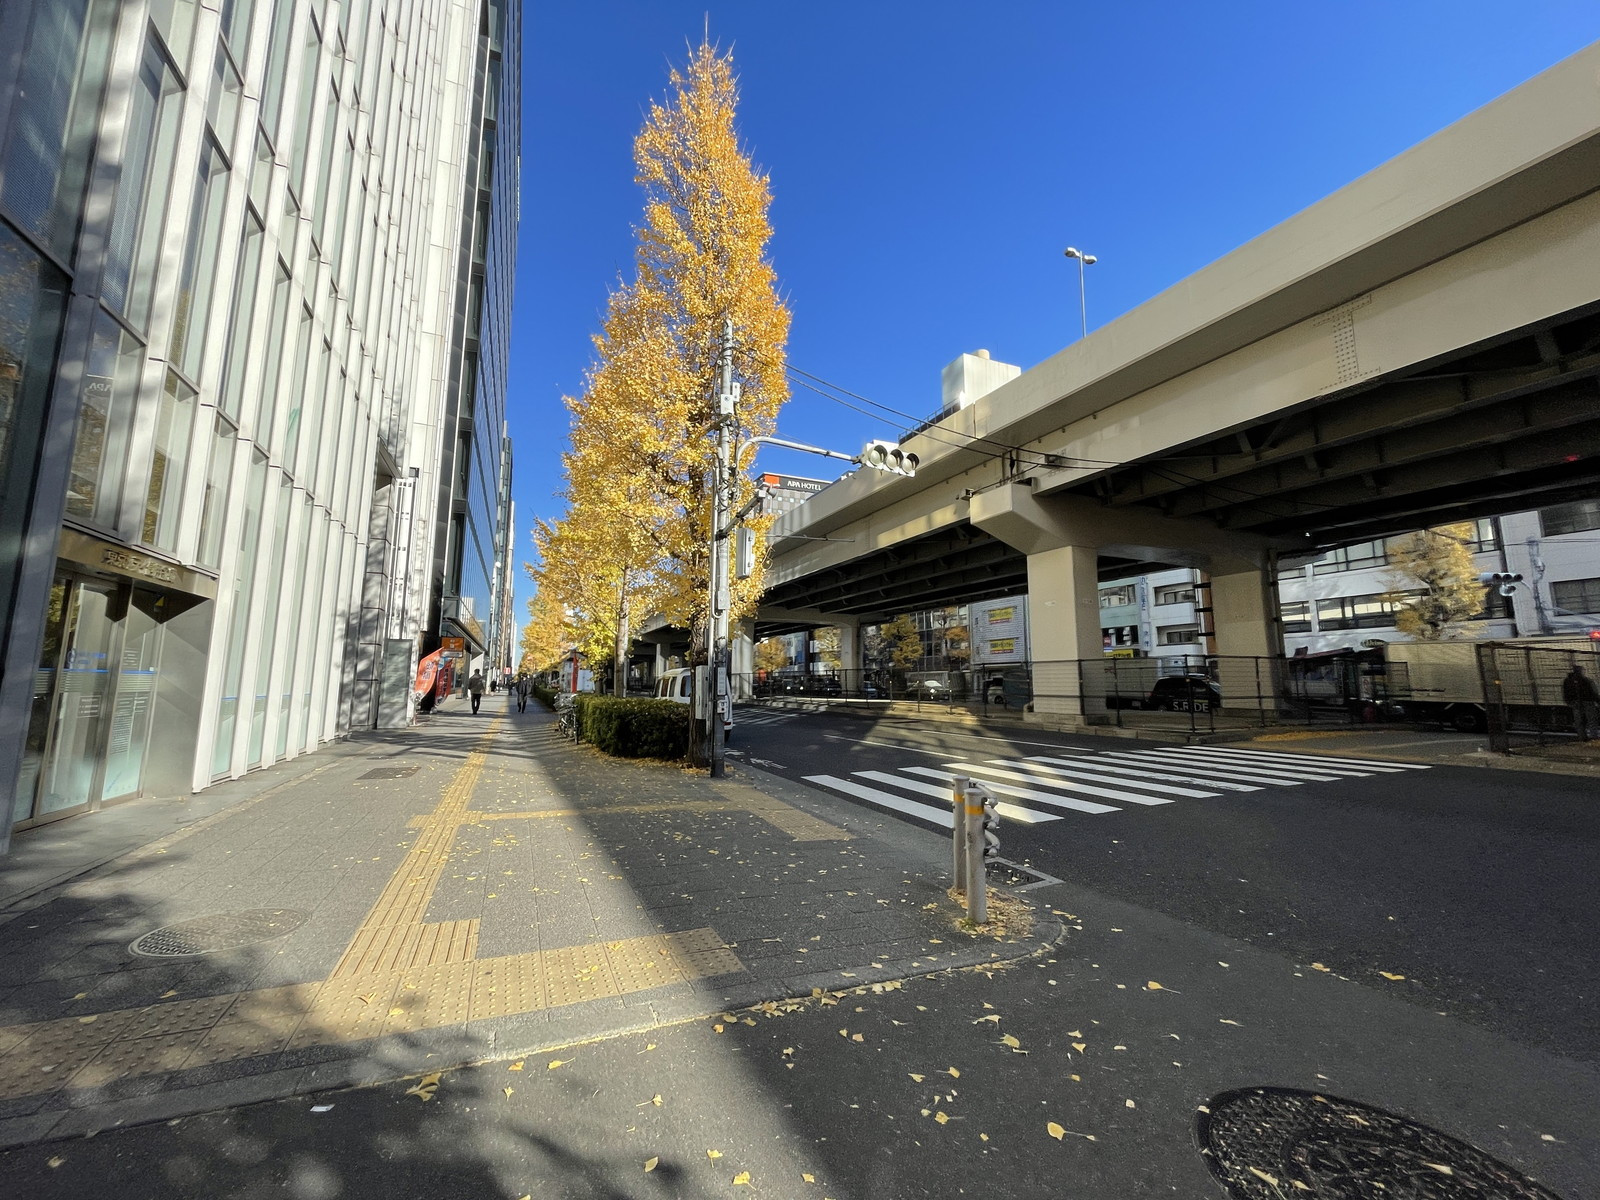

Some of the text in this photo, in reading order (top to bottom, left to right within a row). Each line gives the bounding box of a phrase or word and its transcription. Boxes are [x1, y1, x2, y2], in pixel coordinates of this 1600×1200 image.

[787, 480, 822, 491] APA HOTEL
[1173, 702, 1210, 713] S.RDE
